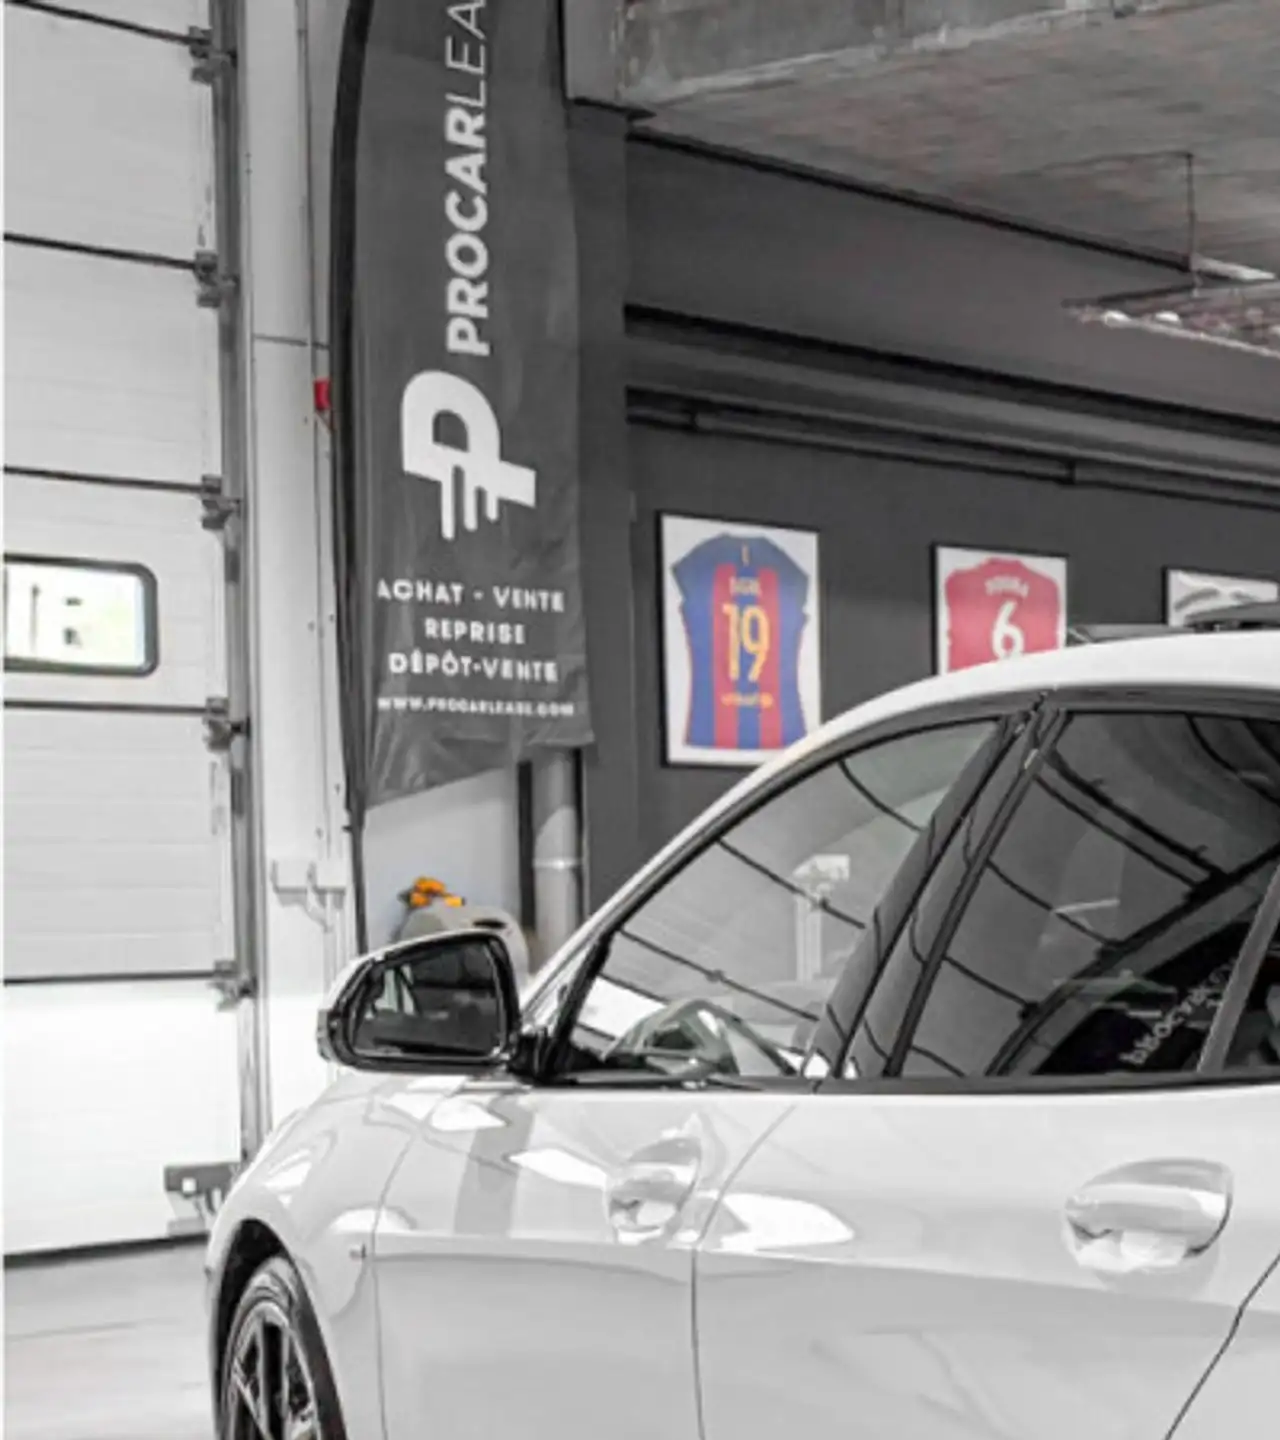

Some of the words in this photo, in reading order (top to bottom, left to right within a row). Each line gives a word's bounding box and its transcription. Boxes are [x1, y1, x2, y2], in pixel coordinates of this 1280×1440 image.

[377, 578, 464, 605] ACHAT
[492, 585, 565, 612] VENTE
[424, 617, 526, 644] REPRISE
[722, 603, 770, 682] 19
[992, 599, 1024, 659] 6
